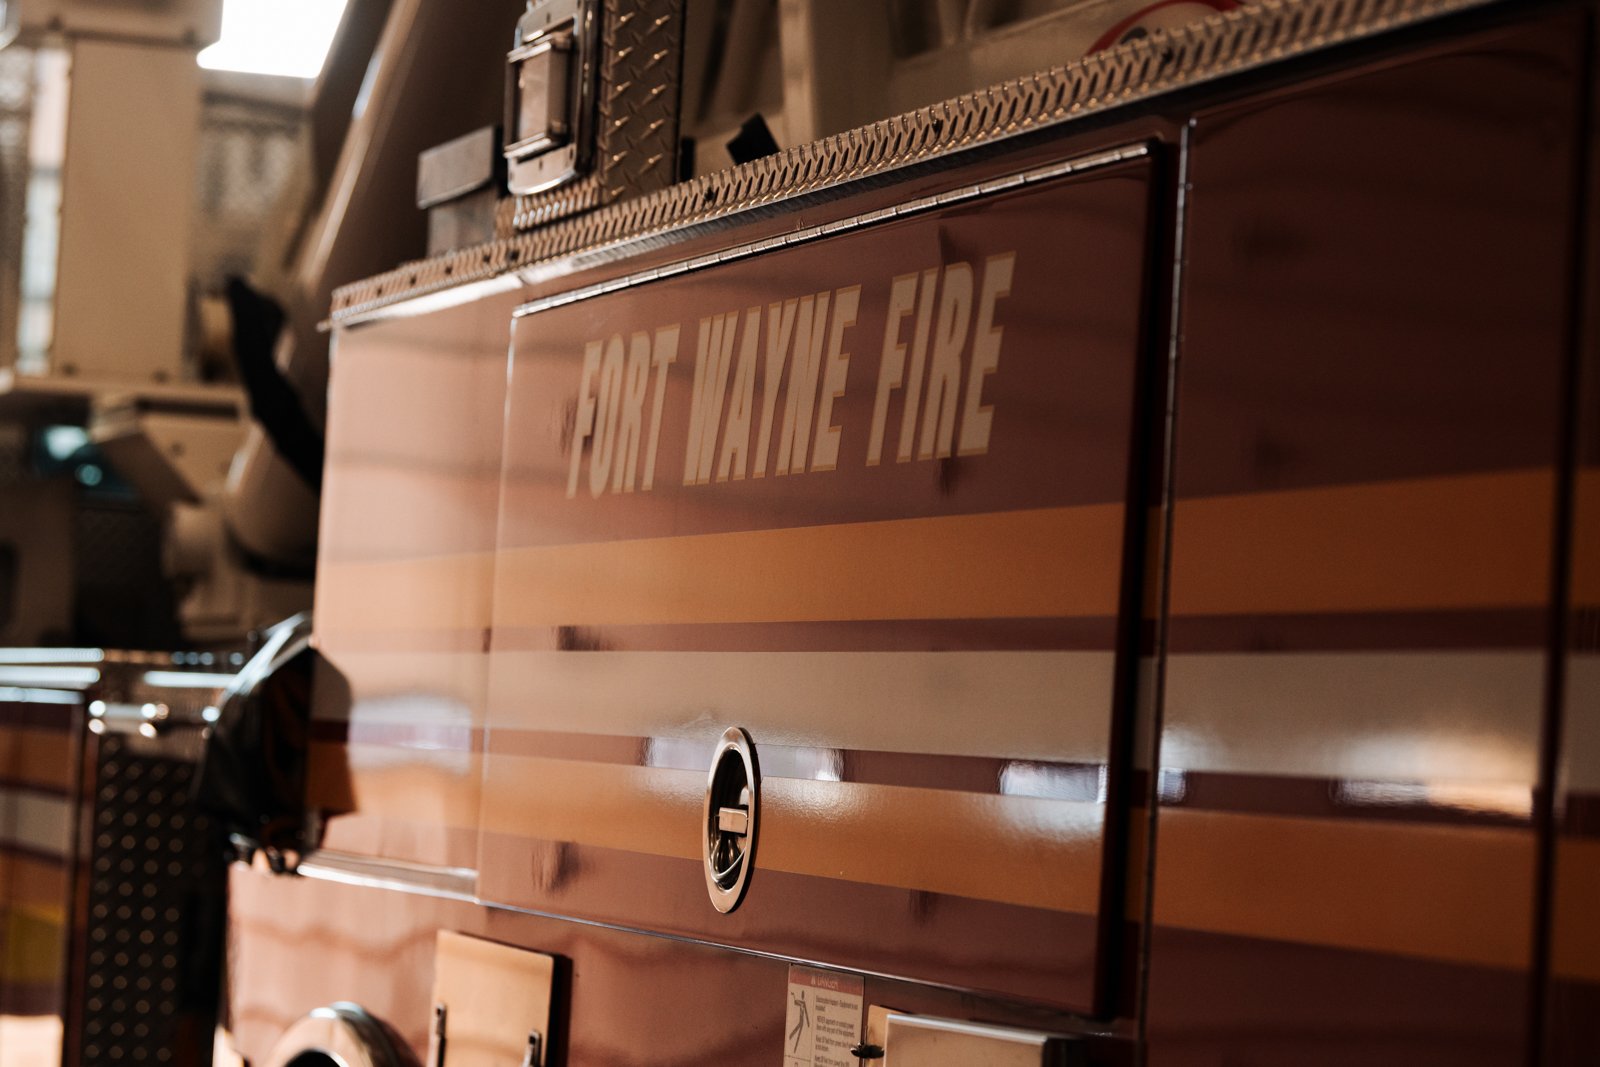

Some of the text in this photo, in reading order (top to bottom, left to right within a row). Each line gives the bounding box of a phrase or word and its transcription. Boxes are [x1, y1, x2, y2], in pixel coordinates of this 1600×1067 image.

[566, 251, 1016, 499] FORT WAYNE FIRE
